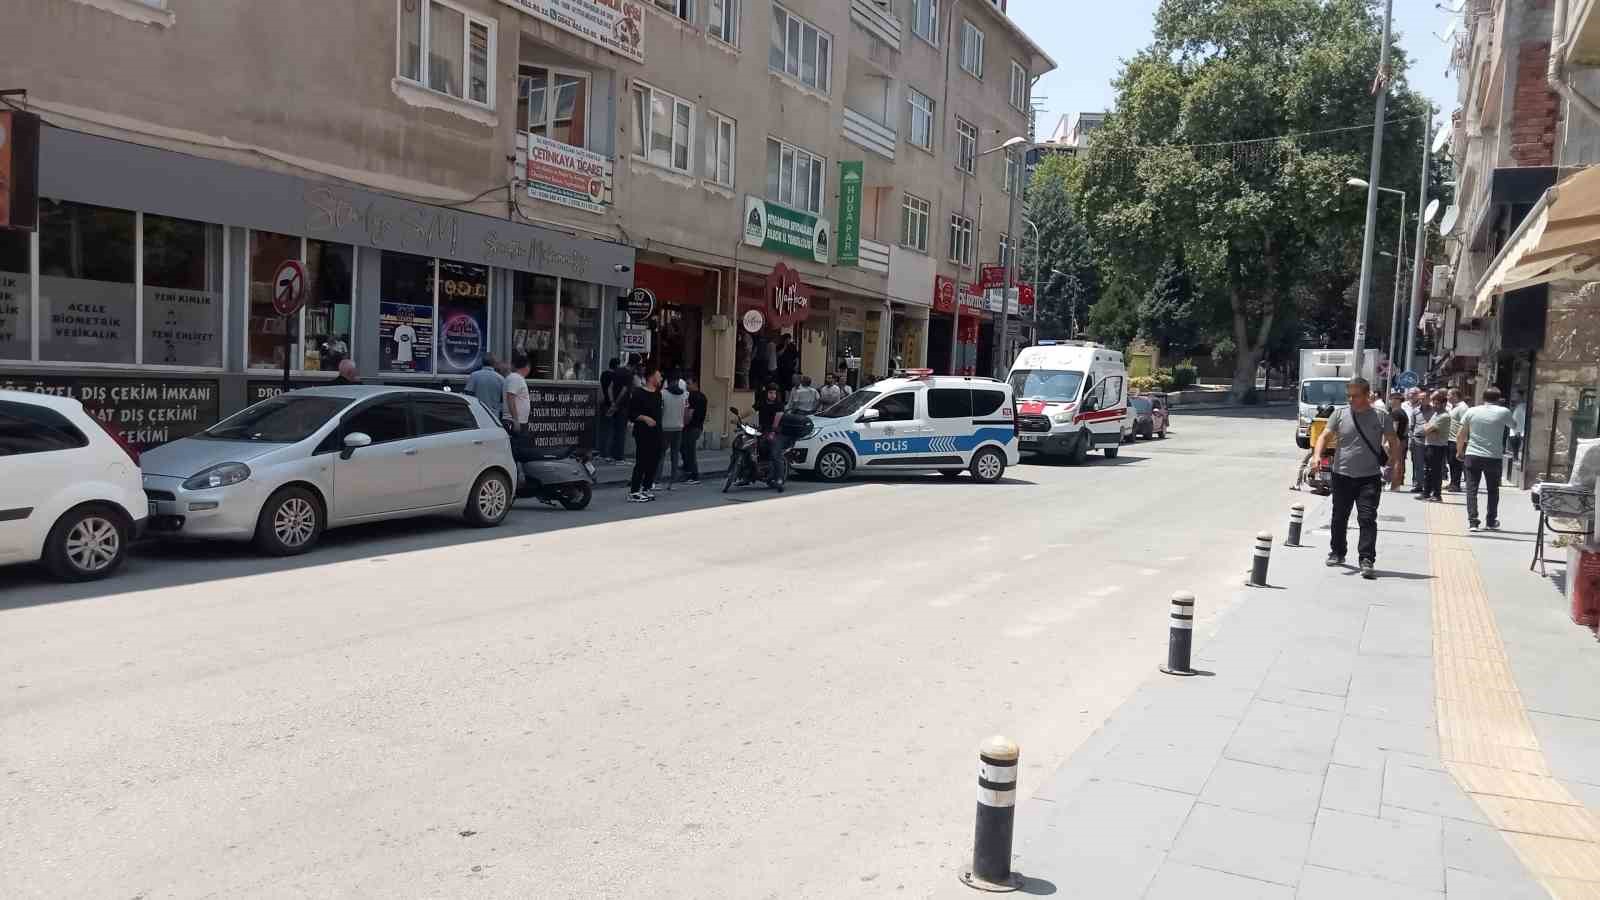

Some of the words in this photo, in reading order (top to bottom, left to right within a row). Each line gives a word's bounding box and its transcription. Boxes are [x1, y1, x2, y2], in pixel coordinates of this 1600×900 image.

[68, 303, 108, 313] ACELE
[110, 383, 158, 405] ÇEKİM
[162, 383, 211, 401] İMKANI
[147, 405, 198, 424] ÇEKİMİ
[874, 440, 908, 452] POLİS
